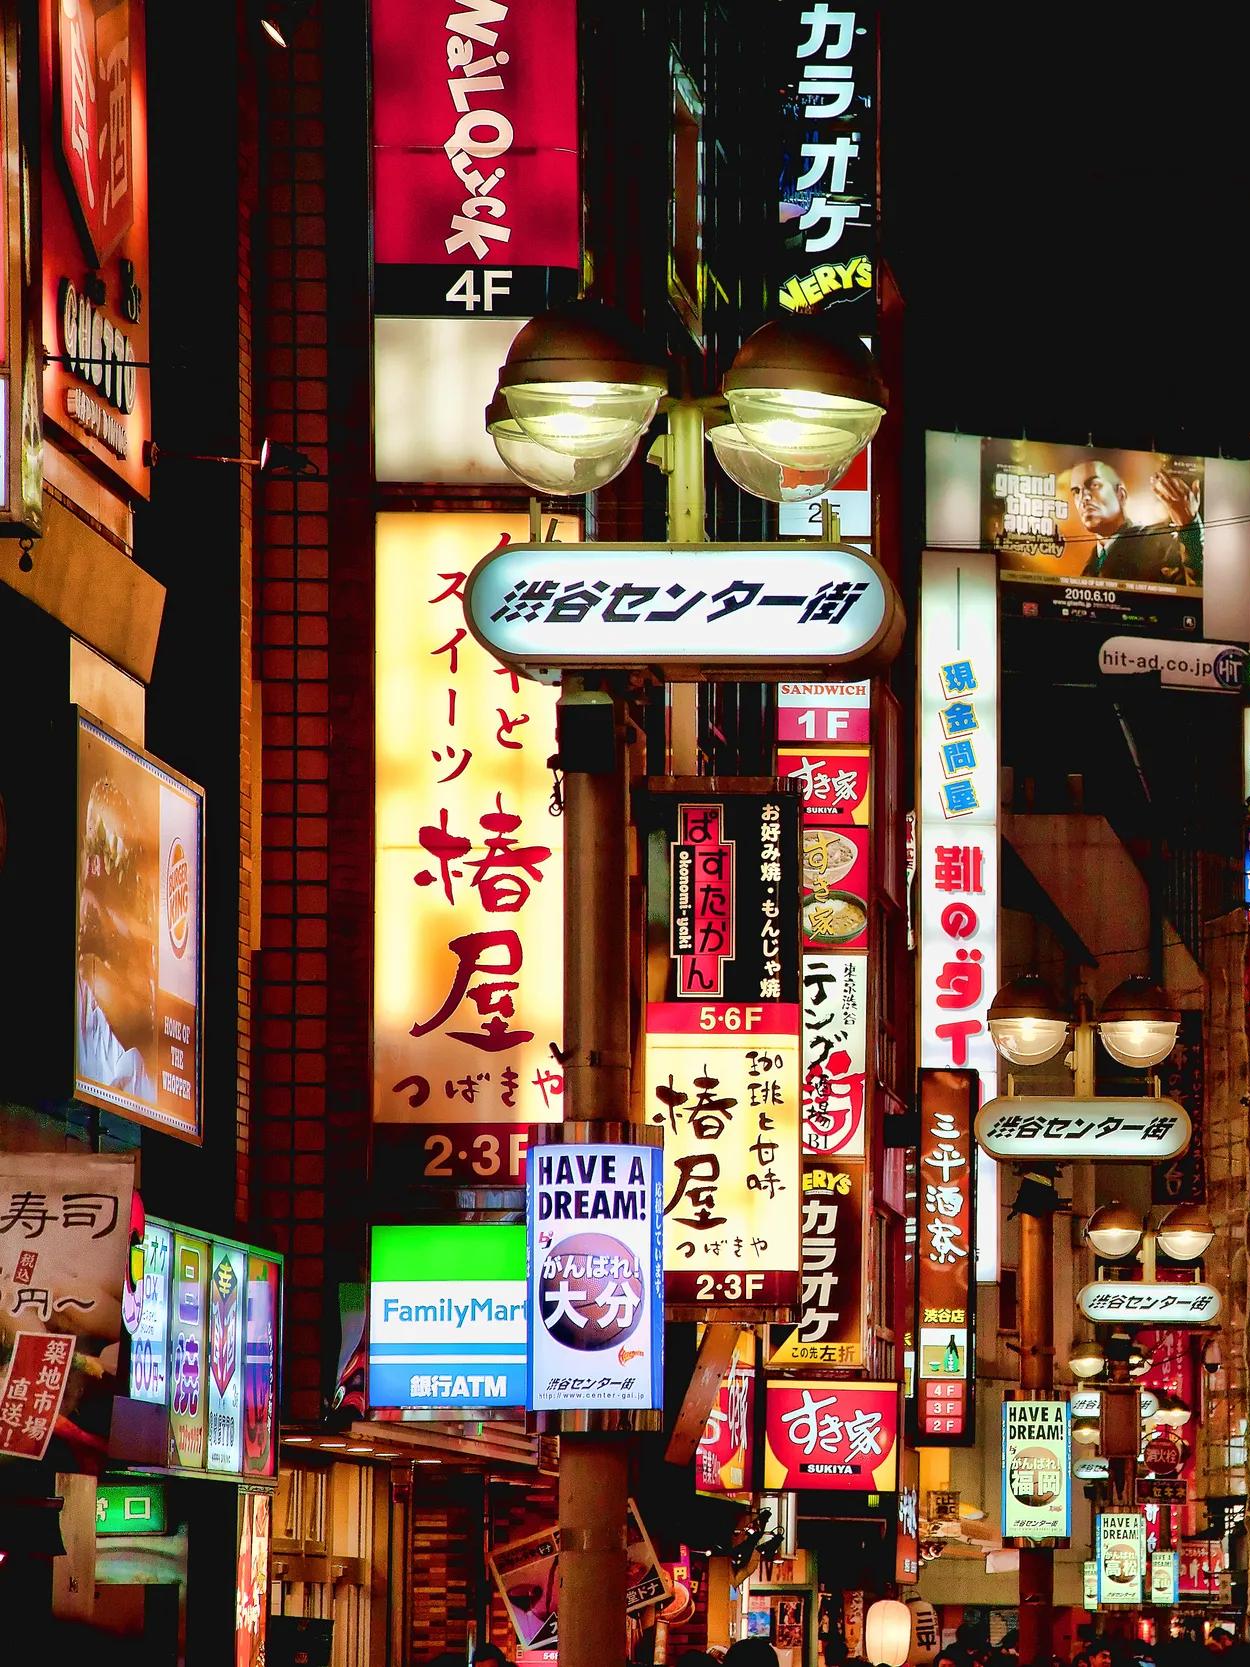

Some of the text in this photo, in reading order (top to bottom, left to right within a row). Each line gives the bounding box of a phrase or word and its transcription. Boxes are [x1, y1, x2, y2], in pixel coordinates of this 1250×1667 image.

[797, 3, 860, 253] カラオケ
[446, 270, 513, 311] 4F
[490, 580, 869, 624] 渋谷センター街
[1065, 588, 1116, 603] 2010.6.10
[428, 572, 473, 784] スイーツ
[1103, 650, 1213, 676] hit-ad.co.jp
[781, 685, 866, 696] SANDWICH
[797, 710, 849, 739] 1F
[943, 659, 980, 814] 現金問屋
[788, 756, 857, 806] すき家
[167, 861, 188, 898] BURGER
[803, 832, 840, 941] すき家
[169, 887, 188, 923] KING
[676, 851, 692, 949] okonomi-yaki
[683, 811, 728, 990] ぱすたかん
[760, 804, 781, 998] お好み焼・もんじゃ焼
[409, 790, 553, 1052] 椿屋
[164, 1016, 191, 1044] HOME OF
[170, 1046, 184, 1070] THE
[162, 1072, 191, 1100] WHOPPER
[392, 1066, 564, 1109] つばきや
[745, 1052, 786, 1199] 珈琲と甘味
[987, 1115, 1177, 1140] 渋谷センター街
[653, 1064, 738, 1230] 椿屋
[539, 1155, 645, 1186] HAVE A
[803, 1169, 852, 1195] ERY'S
[1, 1191, 119, 1239] 寿司
[539, 1191, 646, 1221] DREAM!
[676, 1237, 767, 1258] つばきや
[543, 1255, 641, 1280] がんばれ!
[802, 1200, 839, 1343] カラオケ
[384, 1298, 527, 1328] FamilyMart
[544, 1281, 641, 1329] 大分
[924, 1309, 965, 1323] 渋谷店
[1088, 1295, 1213, 1311] 渋谷センター街
[791, 1345, 855, 1362] この先左折
[22, 1340, 69, 1440] 築地市場
[410, 1375, 507, 1398] 銀行ATM
[547, 1377, 635, 1391] 渋谷センター街
[781, 1390, 883, 1462] すき家
[1009, 1406, 1063, 1422] HAVE A
[1009, 1424, 1064, 1440] DREAM!
[807, 1464, 853, 1474] SUKIYA
[1012, 1471, 1060, 1496] 福岡
[1103, 1518, 1130, 1527] HAVE
[1103, 1529, 1139, 1540] DREAM!
